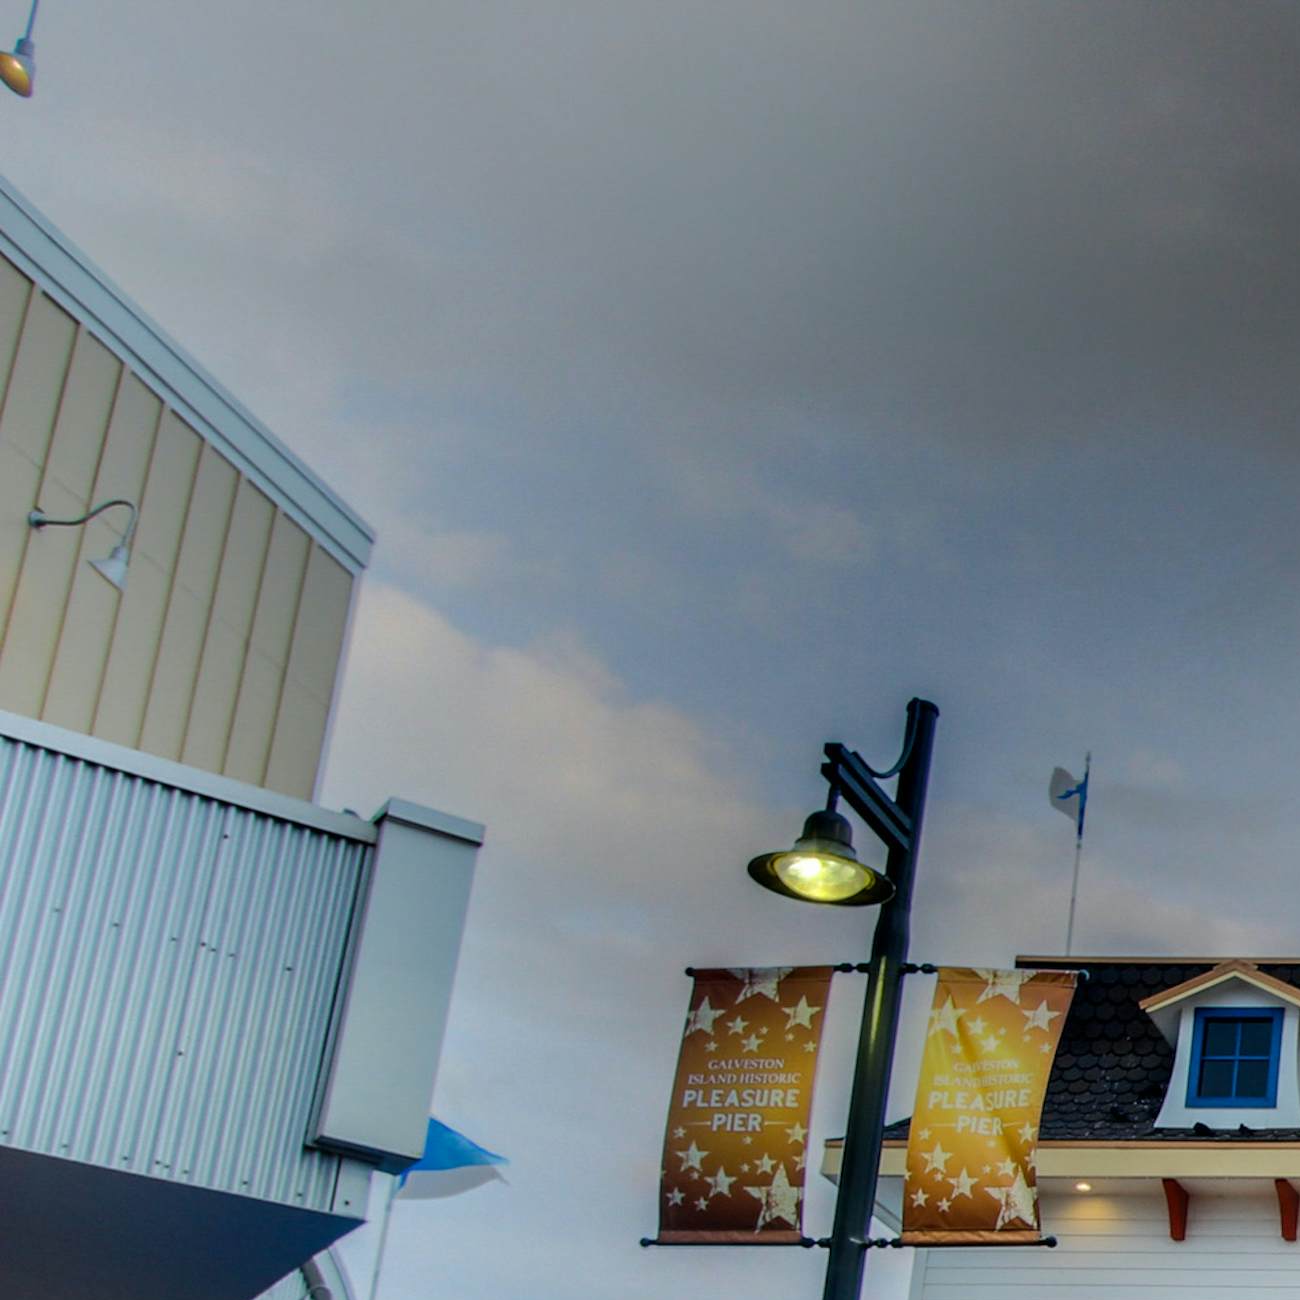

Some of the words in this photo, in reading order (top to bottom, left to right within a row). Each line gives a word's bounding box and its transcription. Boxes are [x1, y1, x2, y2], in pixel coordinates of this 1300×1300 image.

[707, 1058, 785, 1071] GALVESTON
[688, 1073, 737, 1085] ISLAND
[739, 1072, 801, 1084] HISTORIC
[682, 1088, 801, 1109] PLEASURE
[927, 1089, 1031, 1112] PLEASURE
[710, 1113, 763, 1133] PIER
[955, 1115, 1003, 1136] PIER
